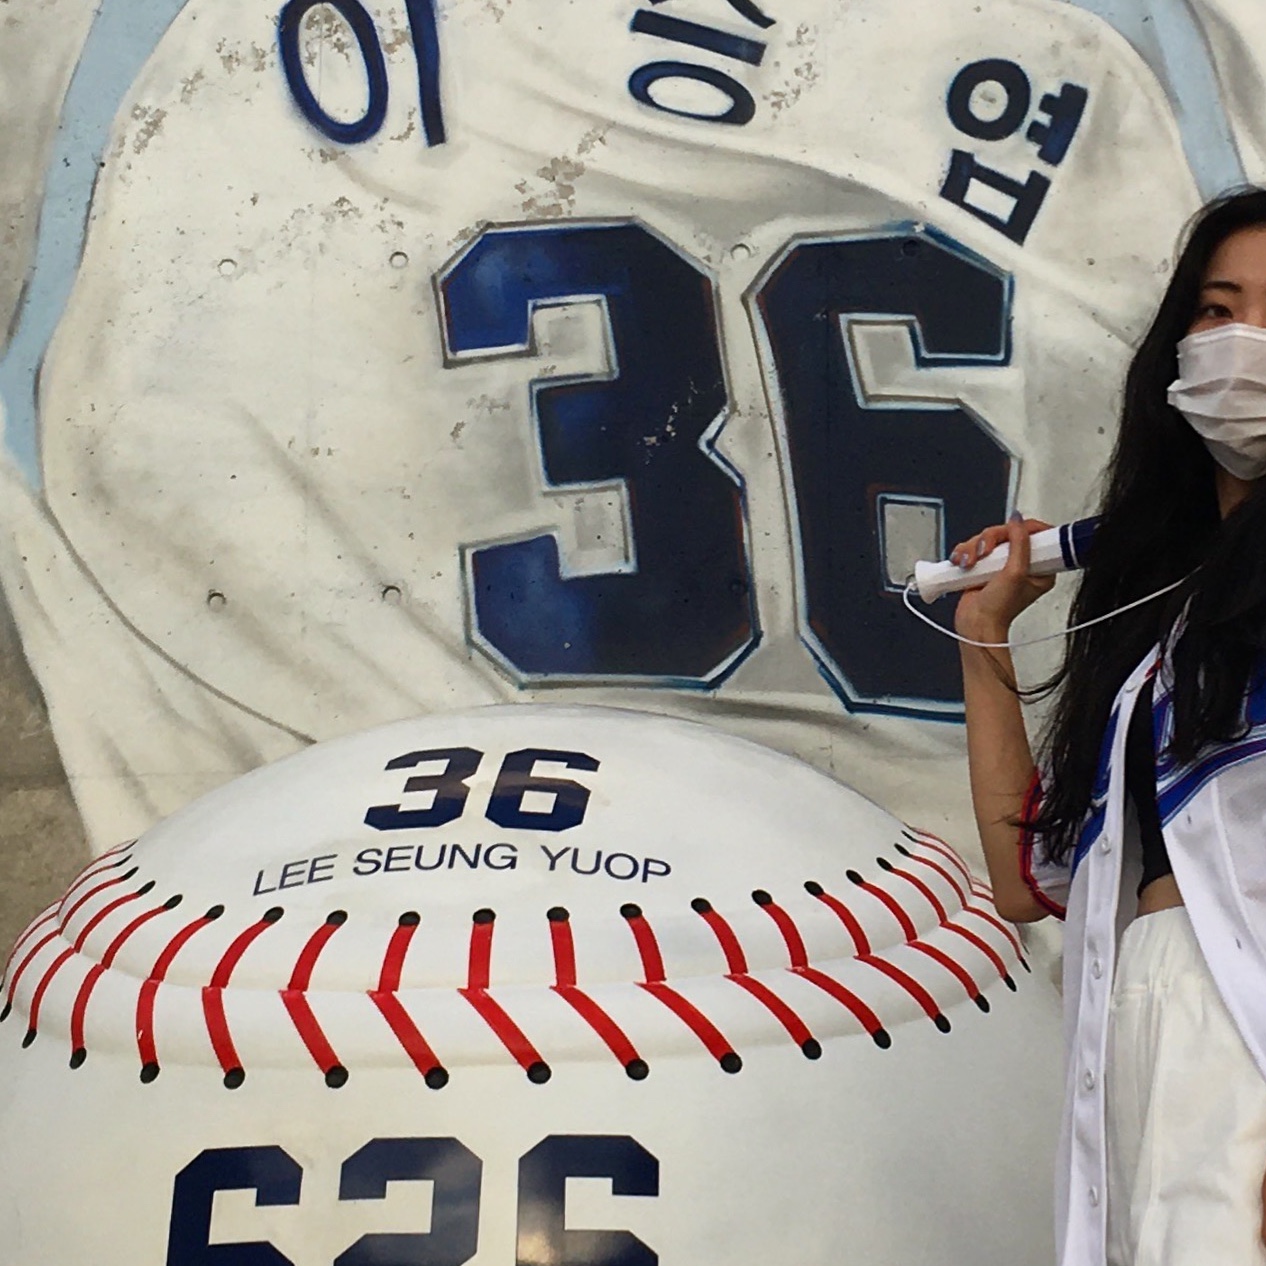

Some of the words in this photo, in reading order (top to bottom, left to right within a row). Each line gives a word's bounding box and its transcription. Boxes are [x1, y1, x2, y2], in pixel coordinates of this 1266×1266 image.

[432, 216, 1021, 722] 36
[363, 746, 601, 832] 36
[252, 853, 338, 897] LEE
[352, 843, 518, 877] SEUNG
[539, 844, 672, 885] YUOP
